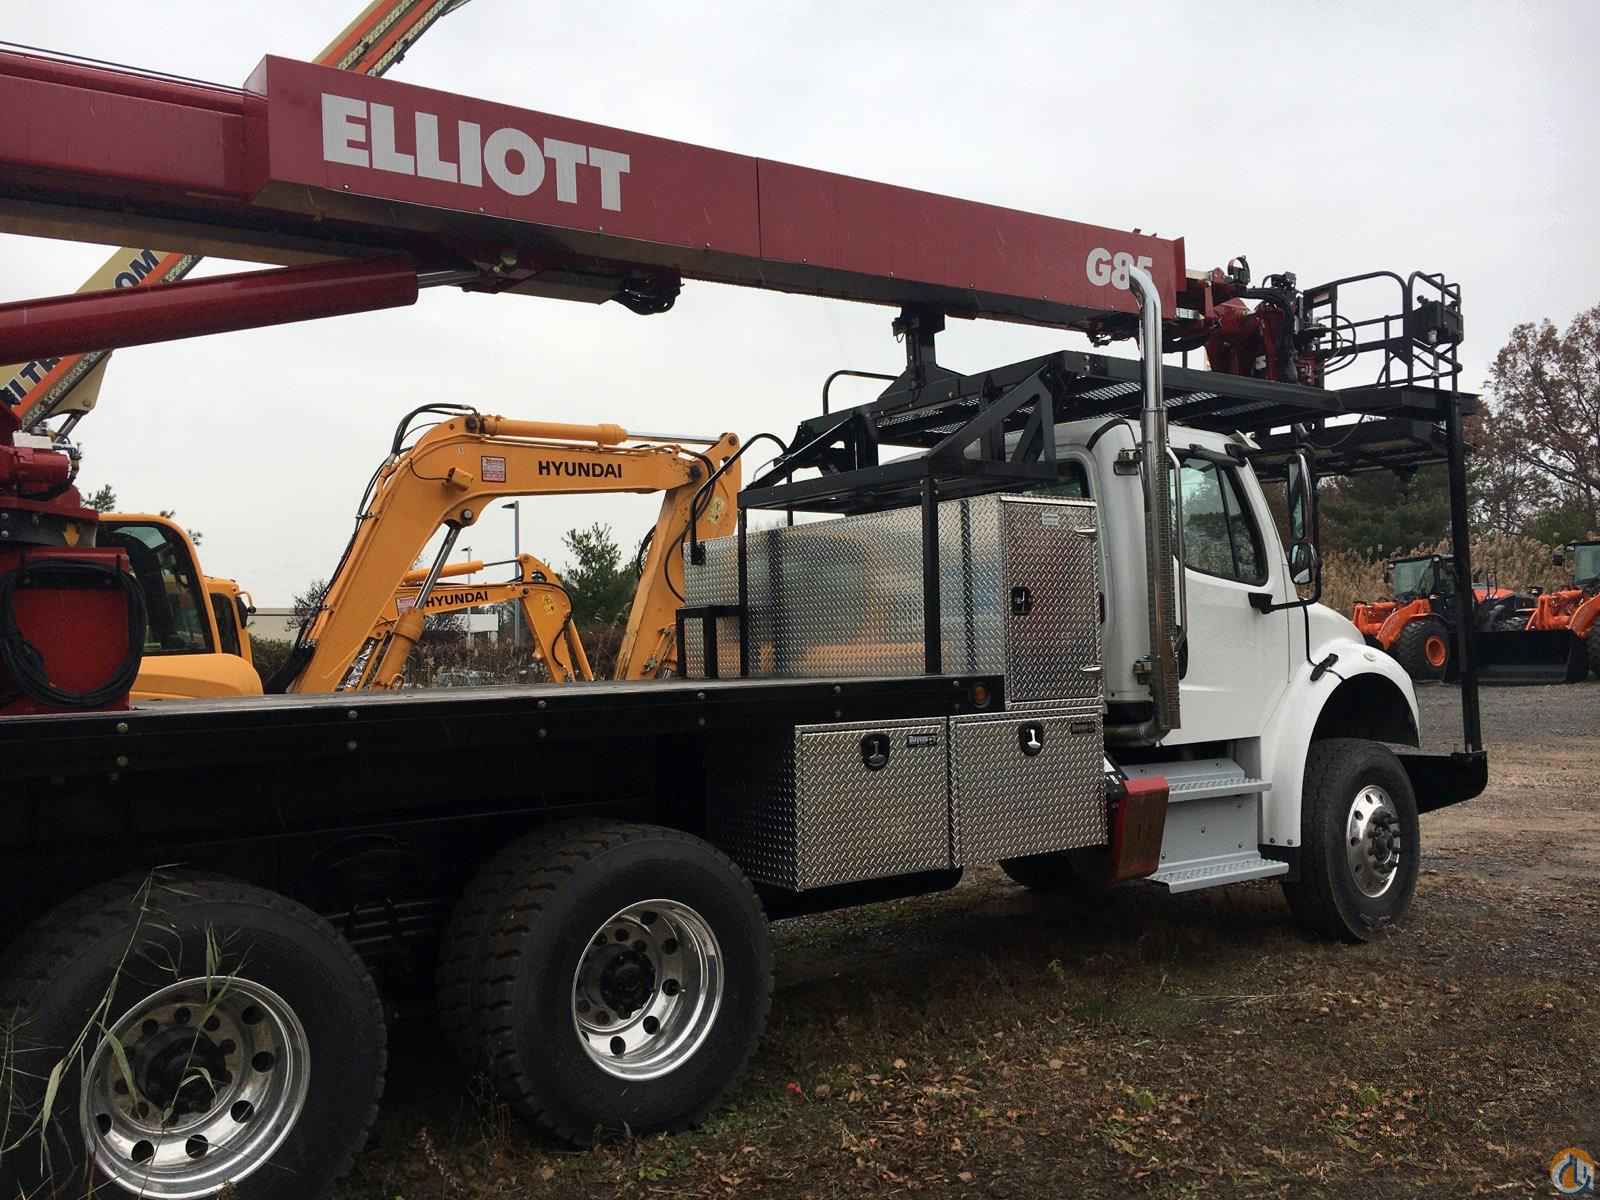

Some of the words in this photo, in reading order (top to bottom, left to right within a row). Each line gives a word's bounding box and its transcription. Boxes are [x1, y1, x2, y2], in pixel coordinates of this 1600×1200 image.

[321, 93, 630, 212] ELLIOTT
[538, 460, 622, 478] HYUNDAI
[426, 591, 488, 607] HYUNDAI
